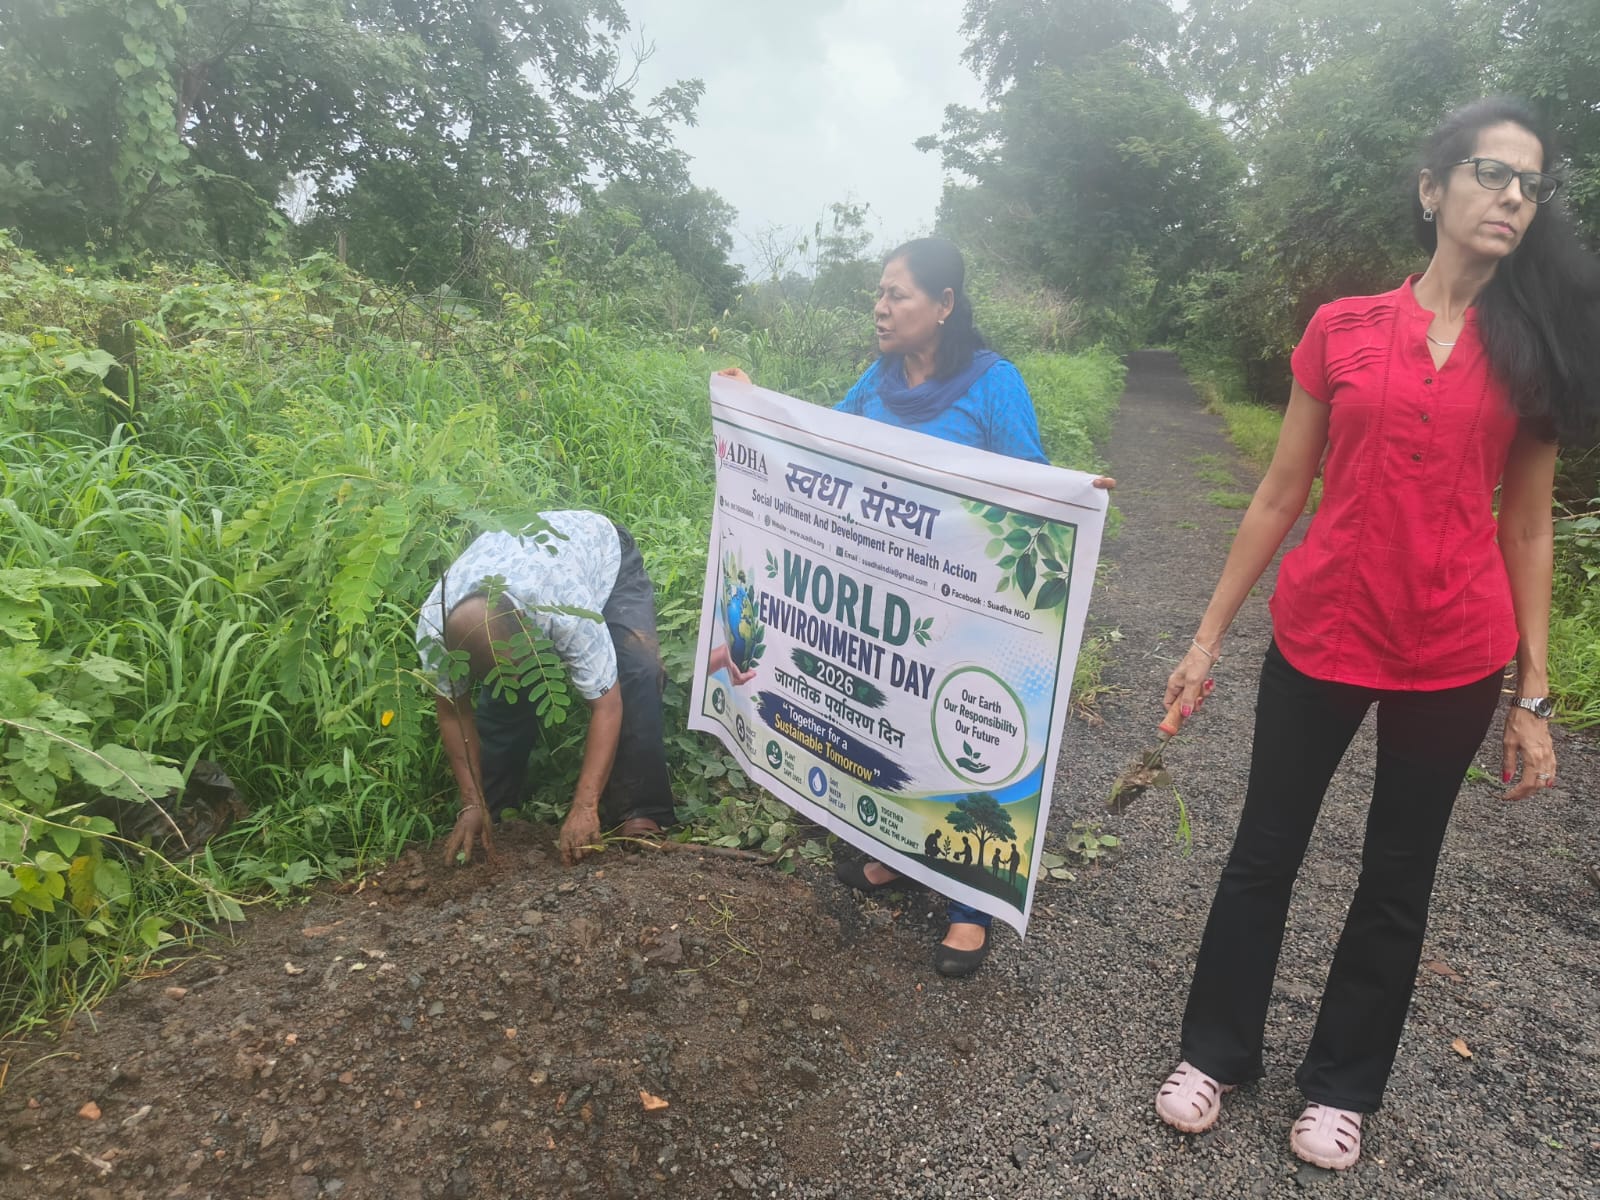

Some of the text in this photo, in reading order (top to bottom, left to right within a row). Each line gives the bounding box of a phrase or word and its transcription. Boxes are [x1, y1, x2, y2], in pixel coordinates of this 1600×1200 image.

[785, 462, 941, 540] स्वधा संस्था
[752, 488, 773, 507] Social
[774, 498, 812, 525] Upliftment
[813, 514, 829, 532] And
[831, 520, 885, 553] Development
[888, 541, 905, 558] For
[906, 548, 940, 571] Health
[942, 559, 978, 583] Action
[844, 550, 858, 562] Email
[783, 548, 911, 647] WORLD
[951, 589, 981, 605] Facebook
[987, 600, 1013, 615] Suadha
[1014, 608, 1031, 621] NGO
[759, 591, 936, 701] ENVIRONMENT DAY
[816, 661, 854, 696] 2026
[774, 666, 905, 749] जागतिक पर्यावरण दिन
[943, 697, 1018, 737] Our Responsibility
[961, 688, 1002, 714] Our Earth
[774, 713, 823, 754] Sustainable
[828, 726, 841, 744] for
[841, 738, 848, 750] a
[955, 719, 1000, 746] Our Future
